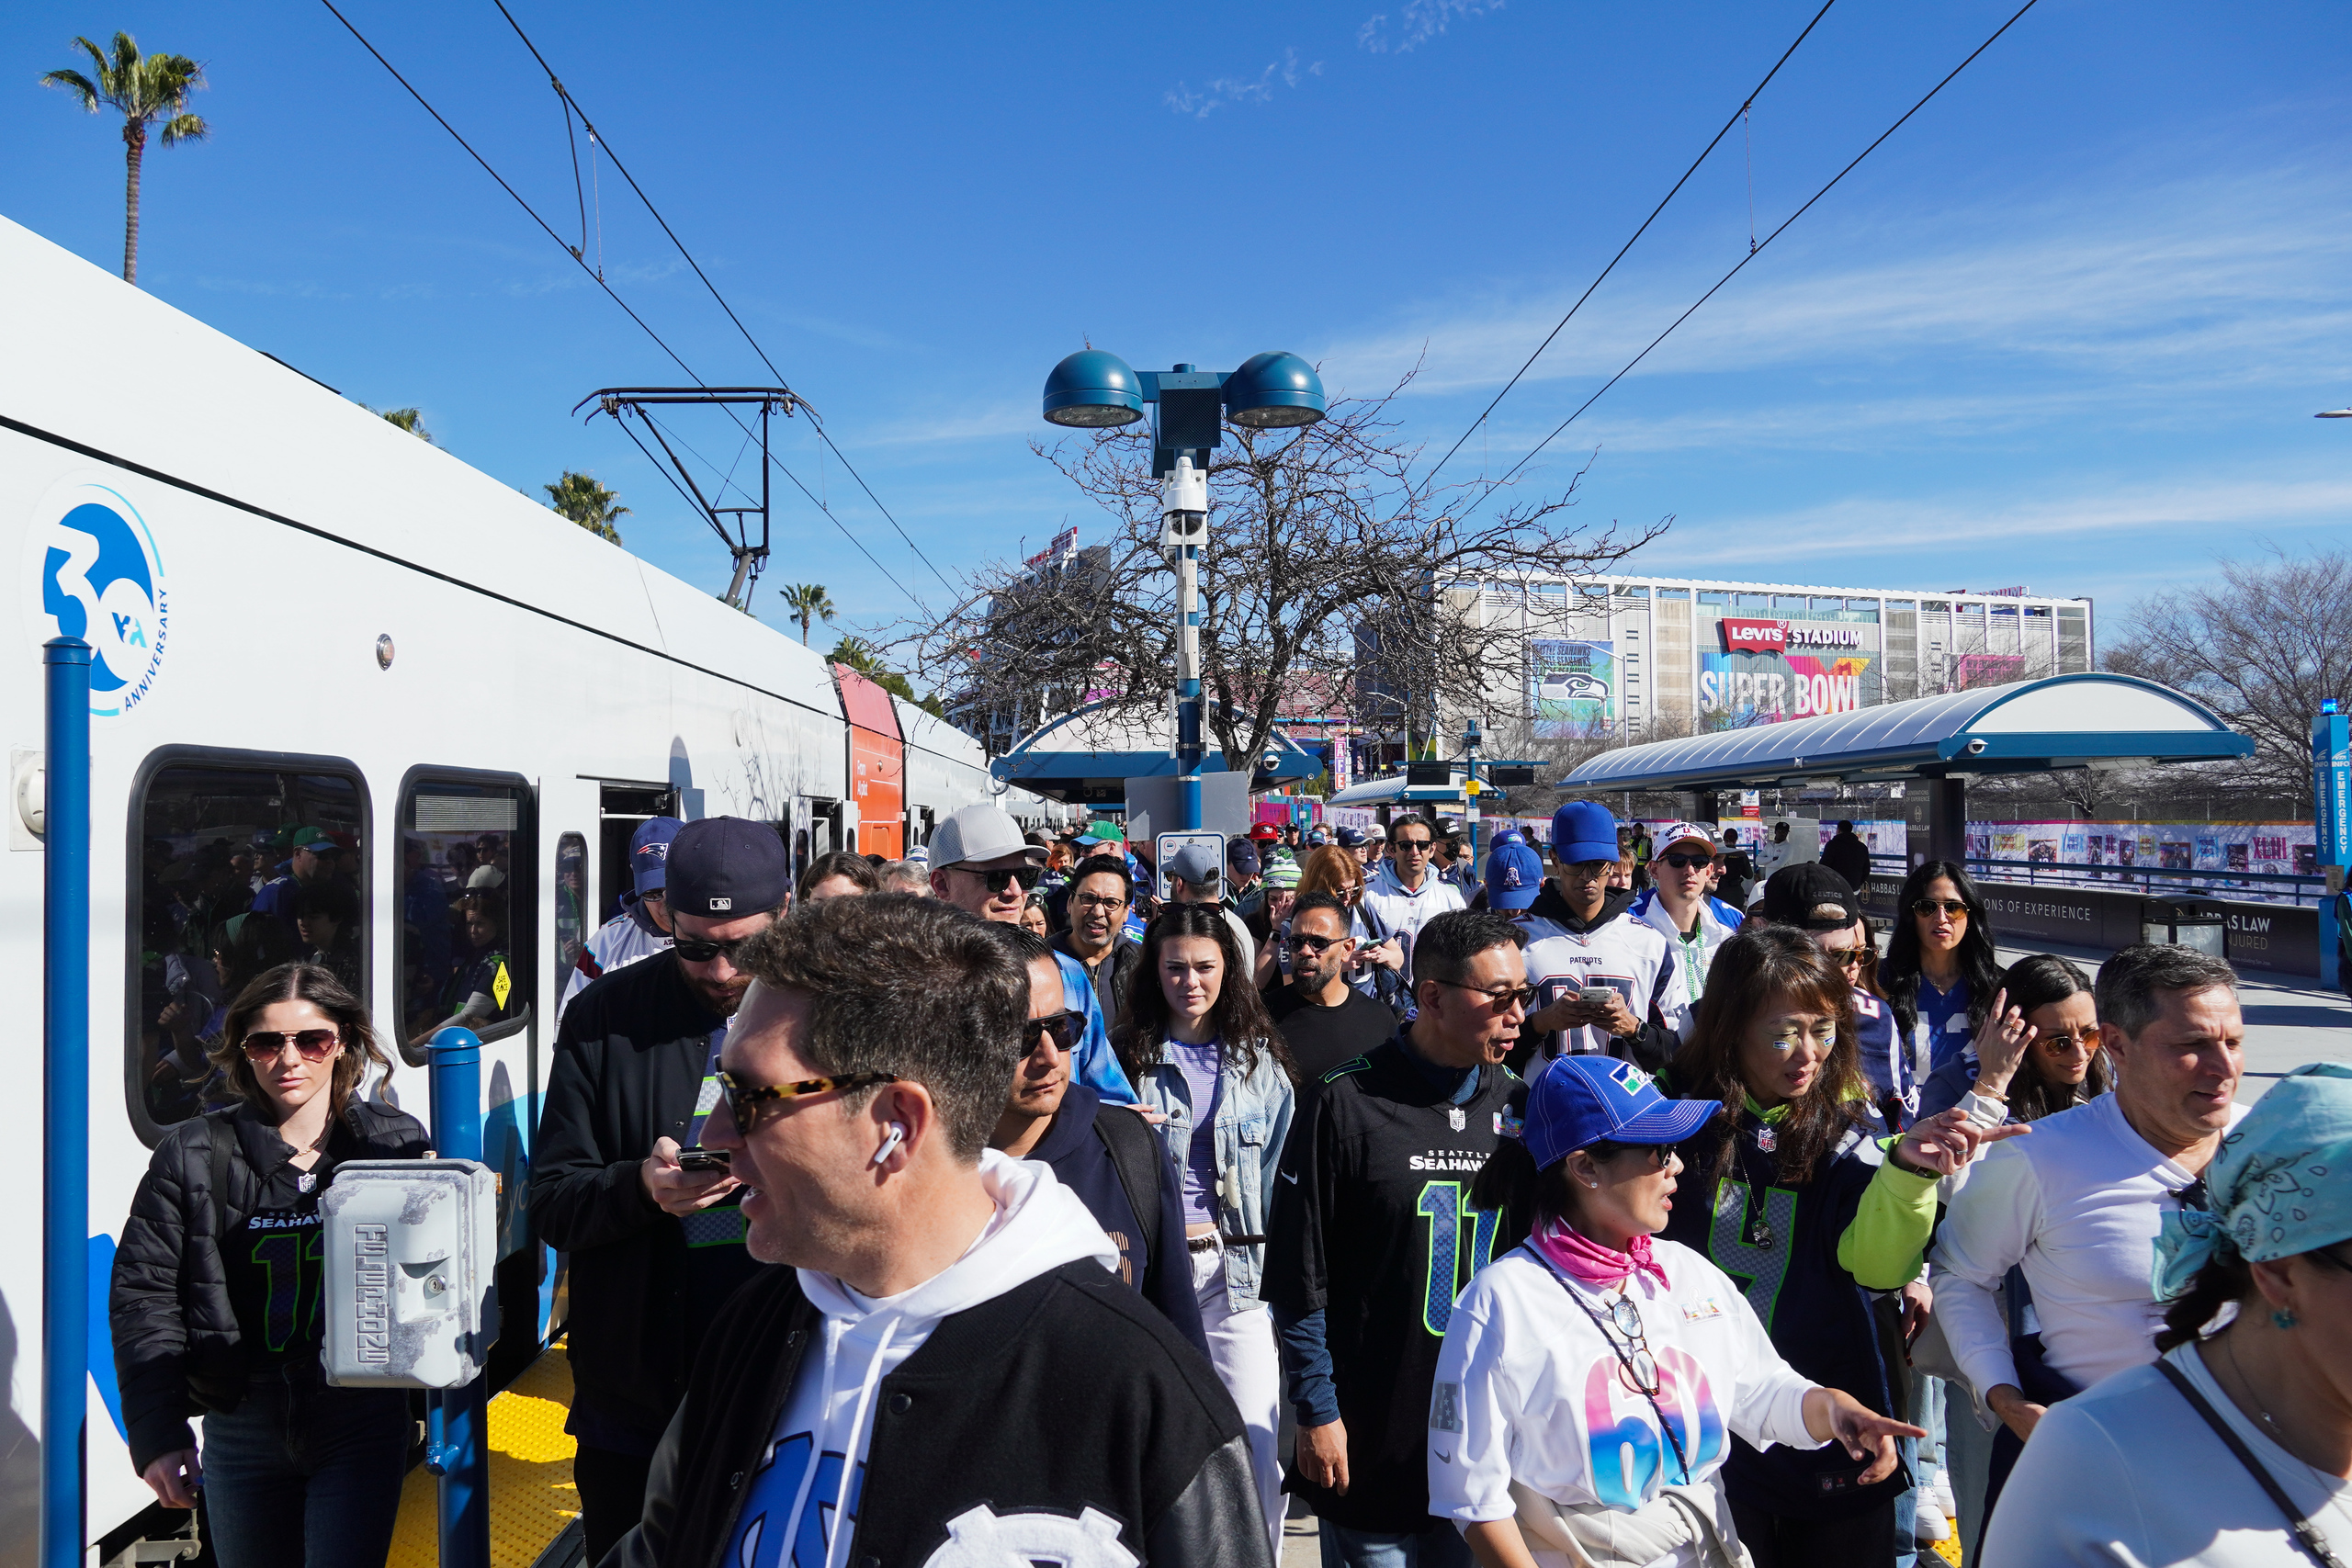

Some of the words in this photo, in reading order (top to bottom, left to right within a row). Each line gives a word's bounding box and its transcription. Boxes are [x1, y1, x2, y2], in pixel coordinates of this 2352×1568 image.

[1792, 628, 1863, 646] STADIUM
[125, 588, 167, 712] ANNIVERSARY
[1557, 645, 1591, 656] SEAHAWKS
[1700, 671, 1786, 715] SUPER
[2319, 772, 2328, 854] EMERGENCY
[2336, 771, 2348, 854] EMERGENCY
[1664, 822, 1687, 838] SUPER
[1812, 891, 1843, 899] CELTICS
[1871, 882, 1896, 895] HABBAS
[2007, 900, 2020, 913] OF
[2024, 902, 2091, 921] EXPERIENCE
[2242, 916, 2270, 933] LAW
[1569, 956, 1602, 964] PATRIOTS
[1409, 1155, 1486, 1172] SEAHAW
[356, 1224, 390, 1364] TELEPHONE
[1584, 1344, 1732, 1512] 60
